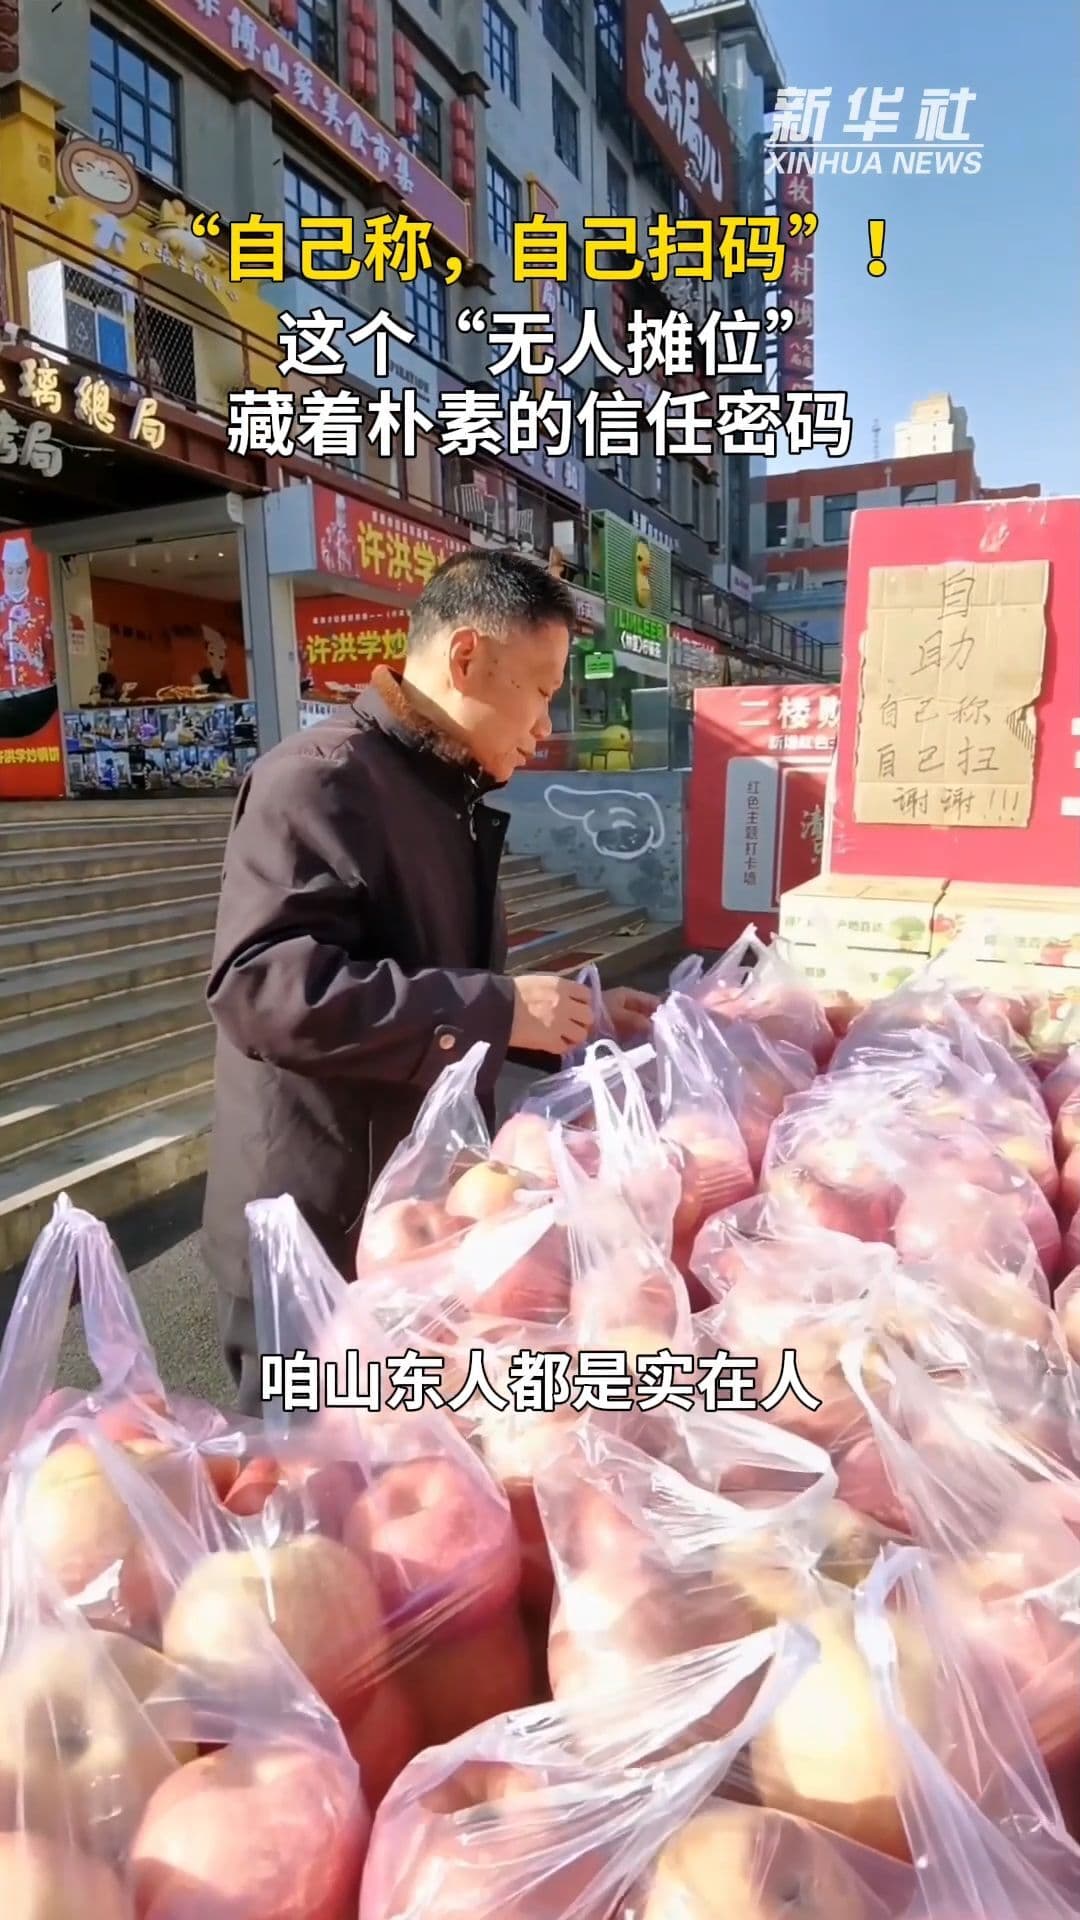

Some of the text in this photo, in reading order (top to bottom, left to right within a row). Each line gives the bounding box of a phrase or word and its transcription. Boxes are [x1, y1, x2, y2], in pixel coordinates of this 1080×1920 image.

[0, 358, 166, 449] 璃總局
[358, 519, 448, 586] 许洪学
[937, 568, 975, 620] 自
[910, 629, 976, 675] 助
[880, 693, 991, 729] 自己称
[876, 736, 1000, 778] 自己扫
